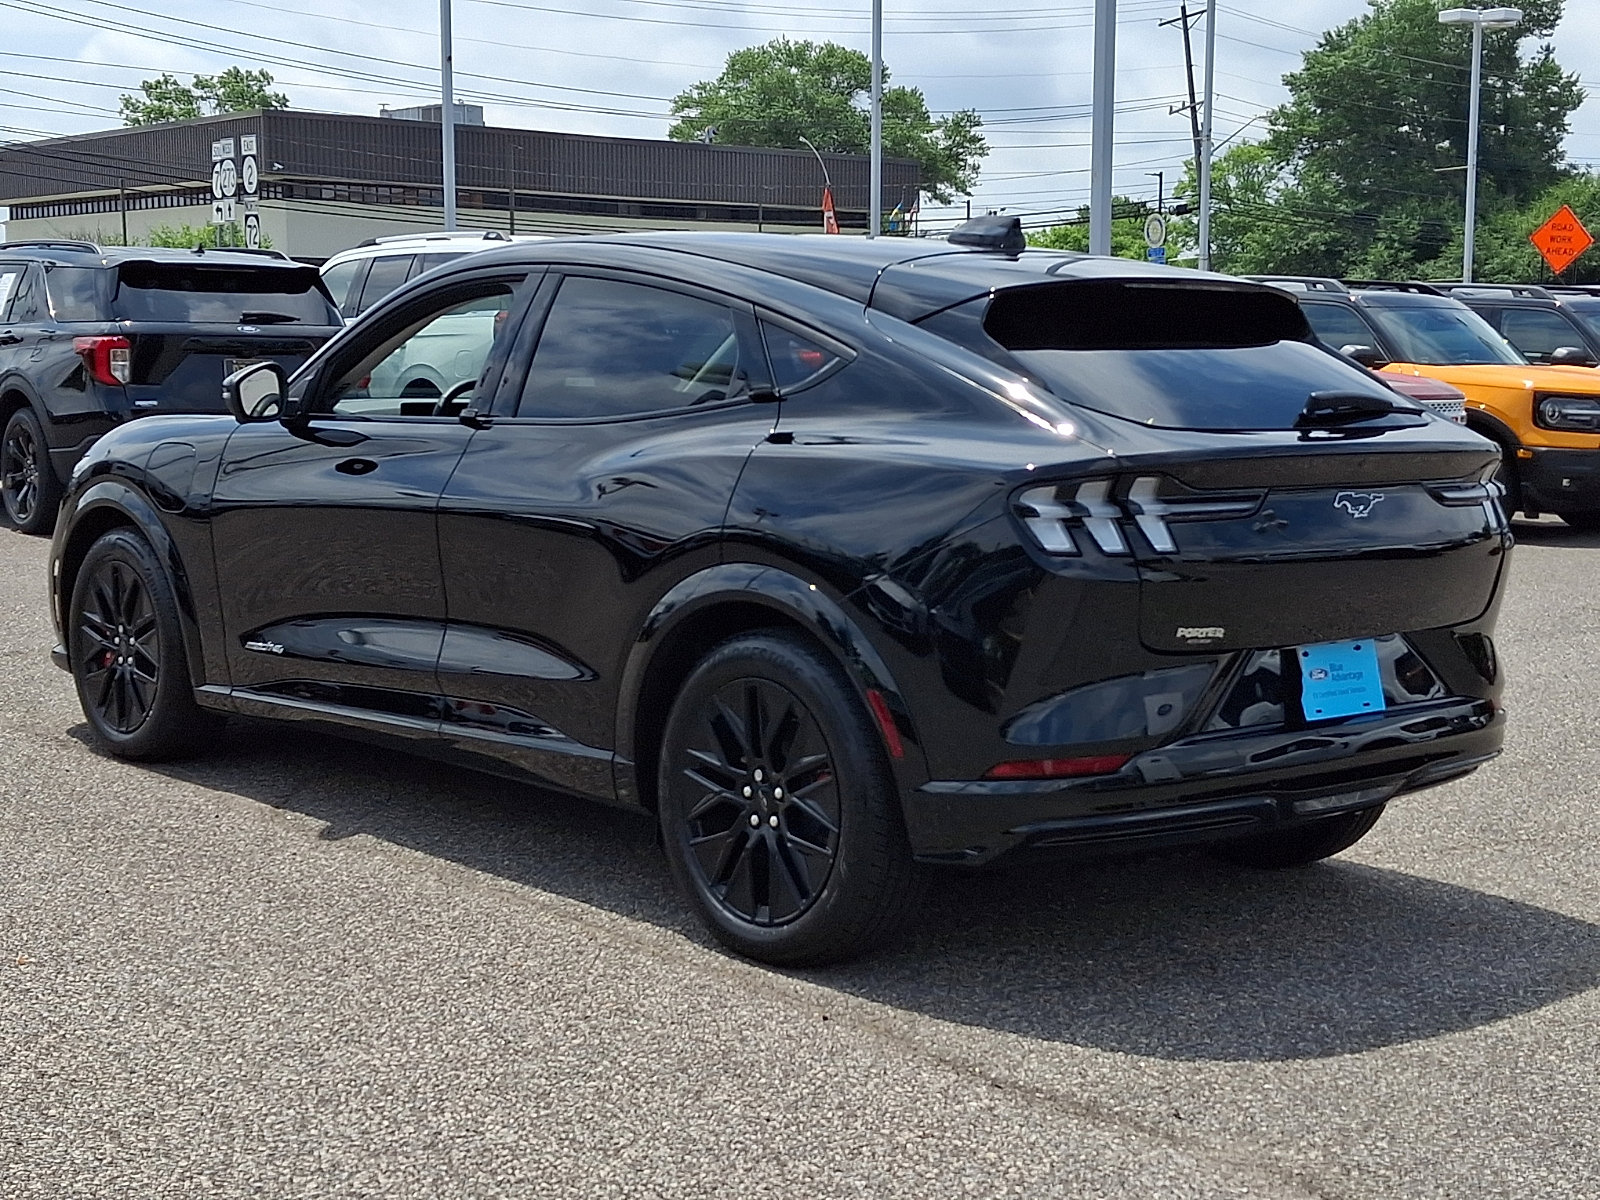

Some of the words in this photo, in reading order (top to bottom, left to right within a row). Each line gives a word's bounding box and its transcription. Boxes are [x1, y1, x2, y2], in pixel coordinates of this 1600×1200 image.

[223, 167, 235, 188] 273
[247, 165, 253, 185] 2
[1551, 223, 1574, 231] ROAD
[247, 224, 258, 245] 72
[1550, 235, 1572, 243] WORK
[1546, 247, 1574, 256] AHEAD
[1176, 627, 1225, 638] PORTER
